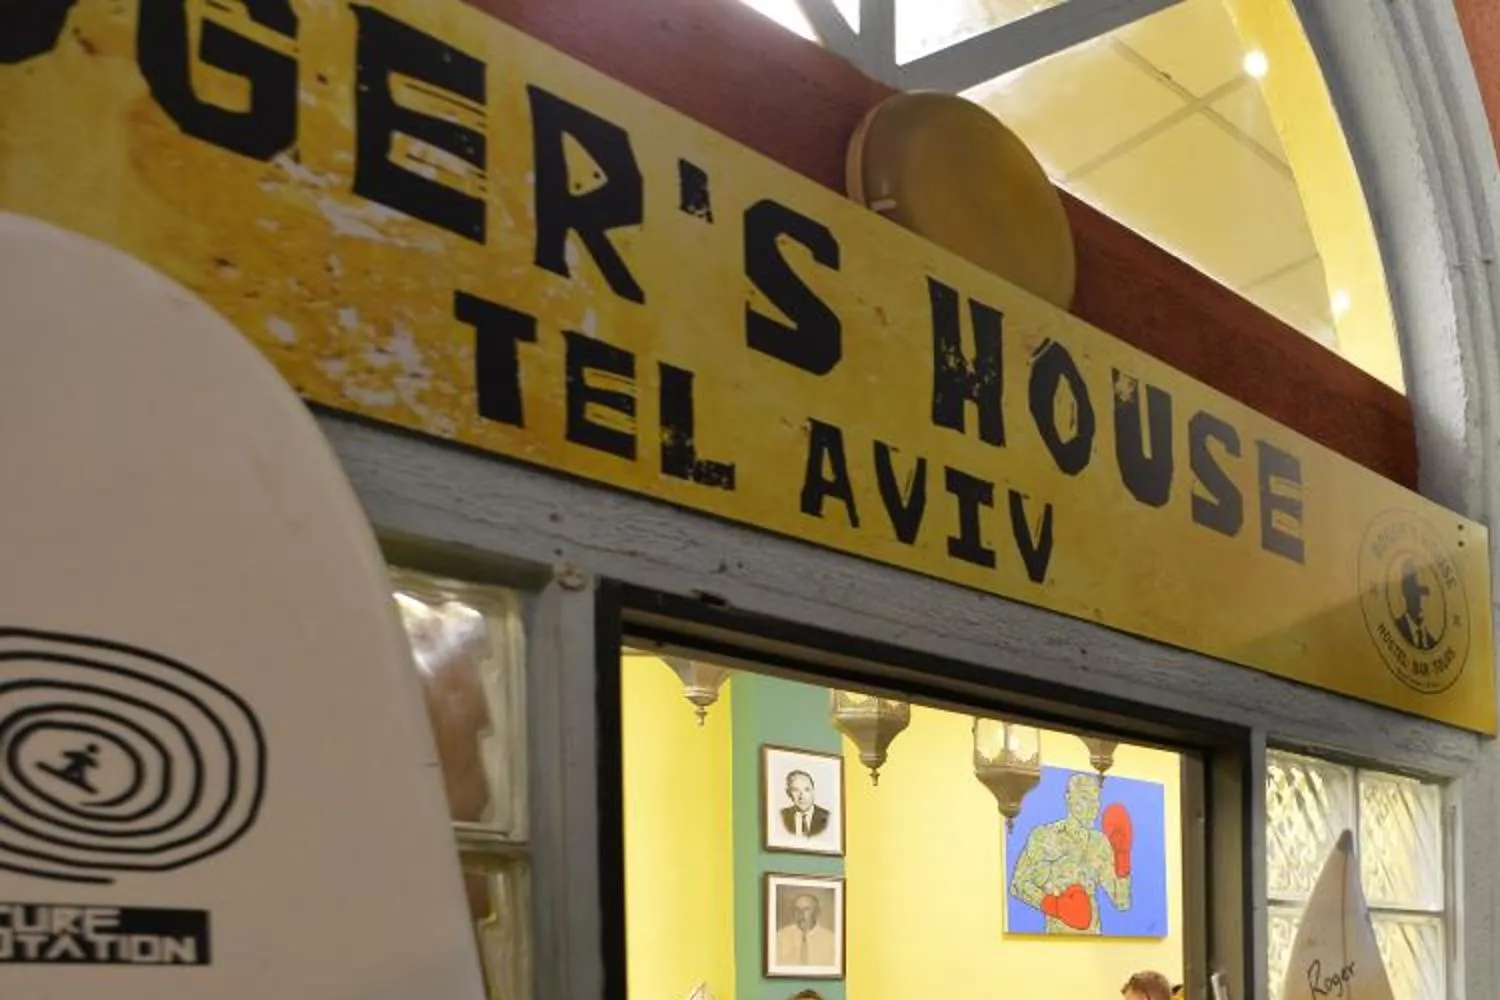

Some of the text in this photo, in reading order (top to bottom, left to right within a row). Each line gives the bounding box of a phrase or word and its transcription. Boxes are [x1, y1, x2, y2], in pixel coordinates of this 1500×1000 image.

[454, 290, 1053, 585] TEL AVIV
[928, 276, 1305, 564] HOUSE
